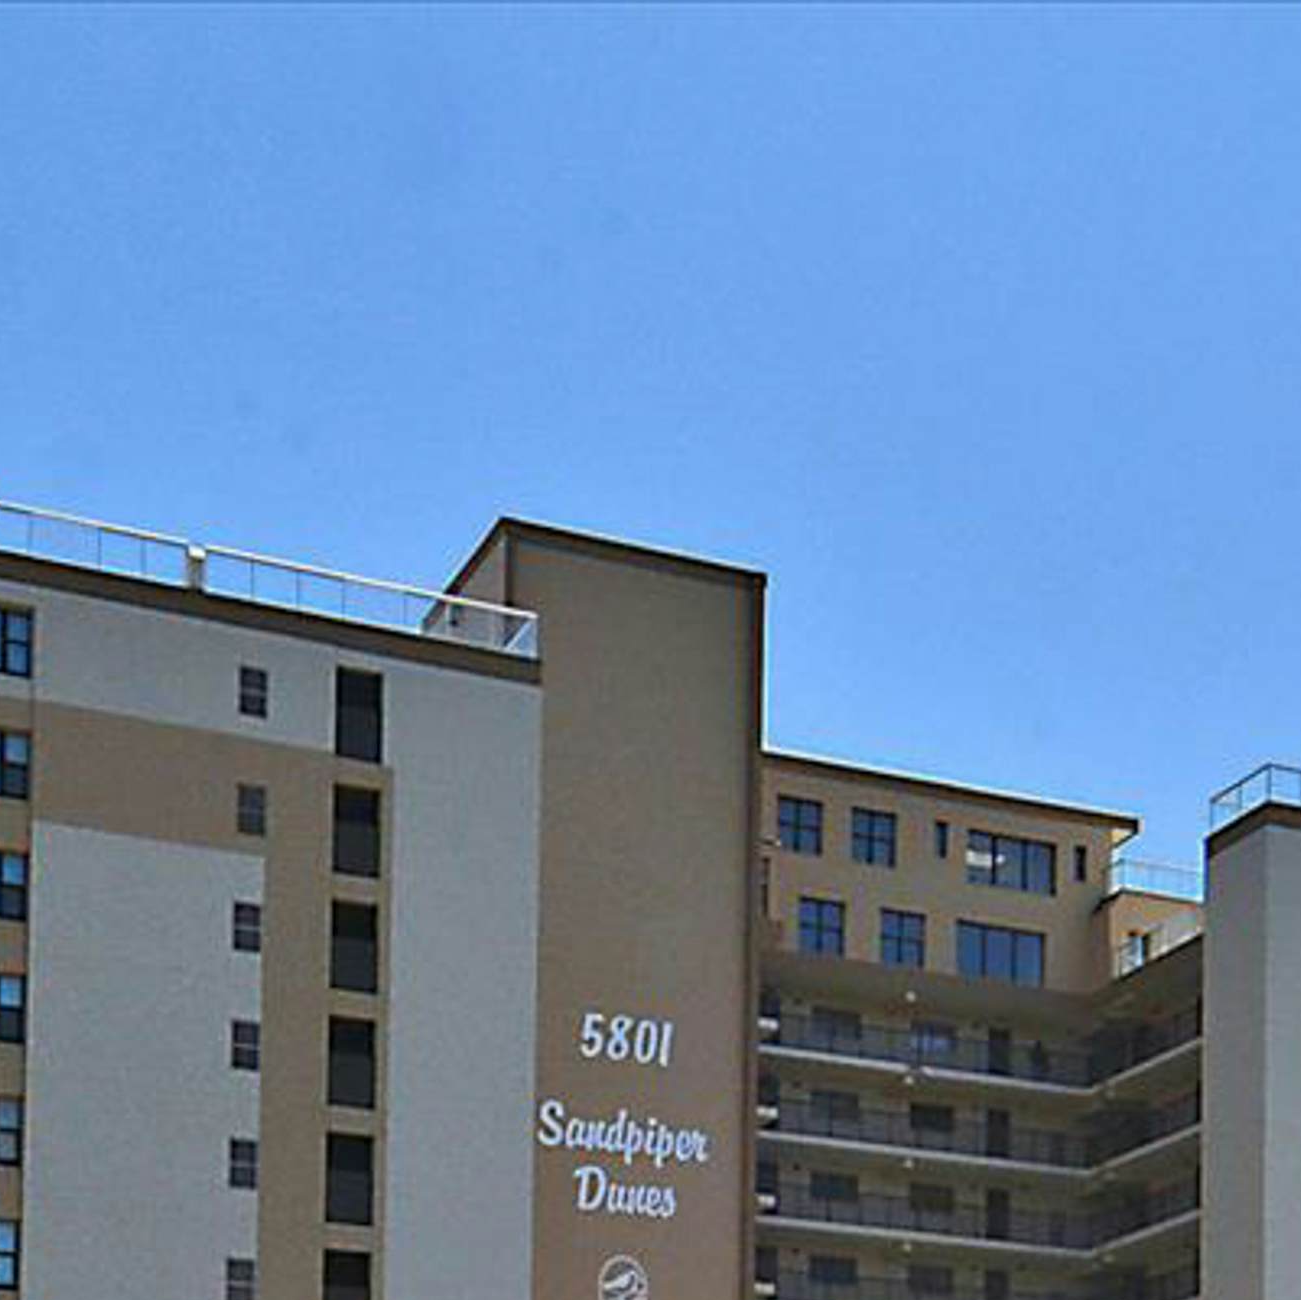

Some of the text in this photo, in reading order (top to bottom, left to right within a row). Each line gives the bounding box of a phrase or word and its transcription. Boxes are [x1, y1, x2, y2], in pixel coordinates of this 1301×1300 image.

[580, 1012, 673, 1067] 5801
[537, 1099, 710, 1168] Sandpiper
[573, 1165, 677, 1218] Dunes
